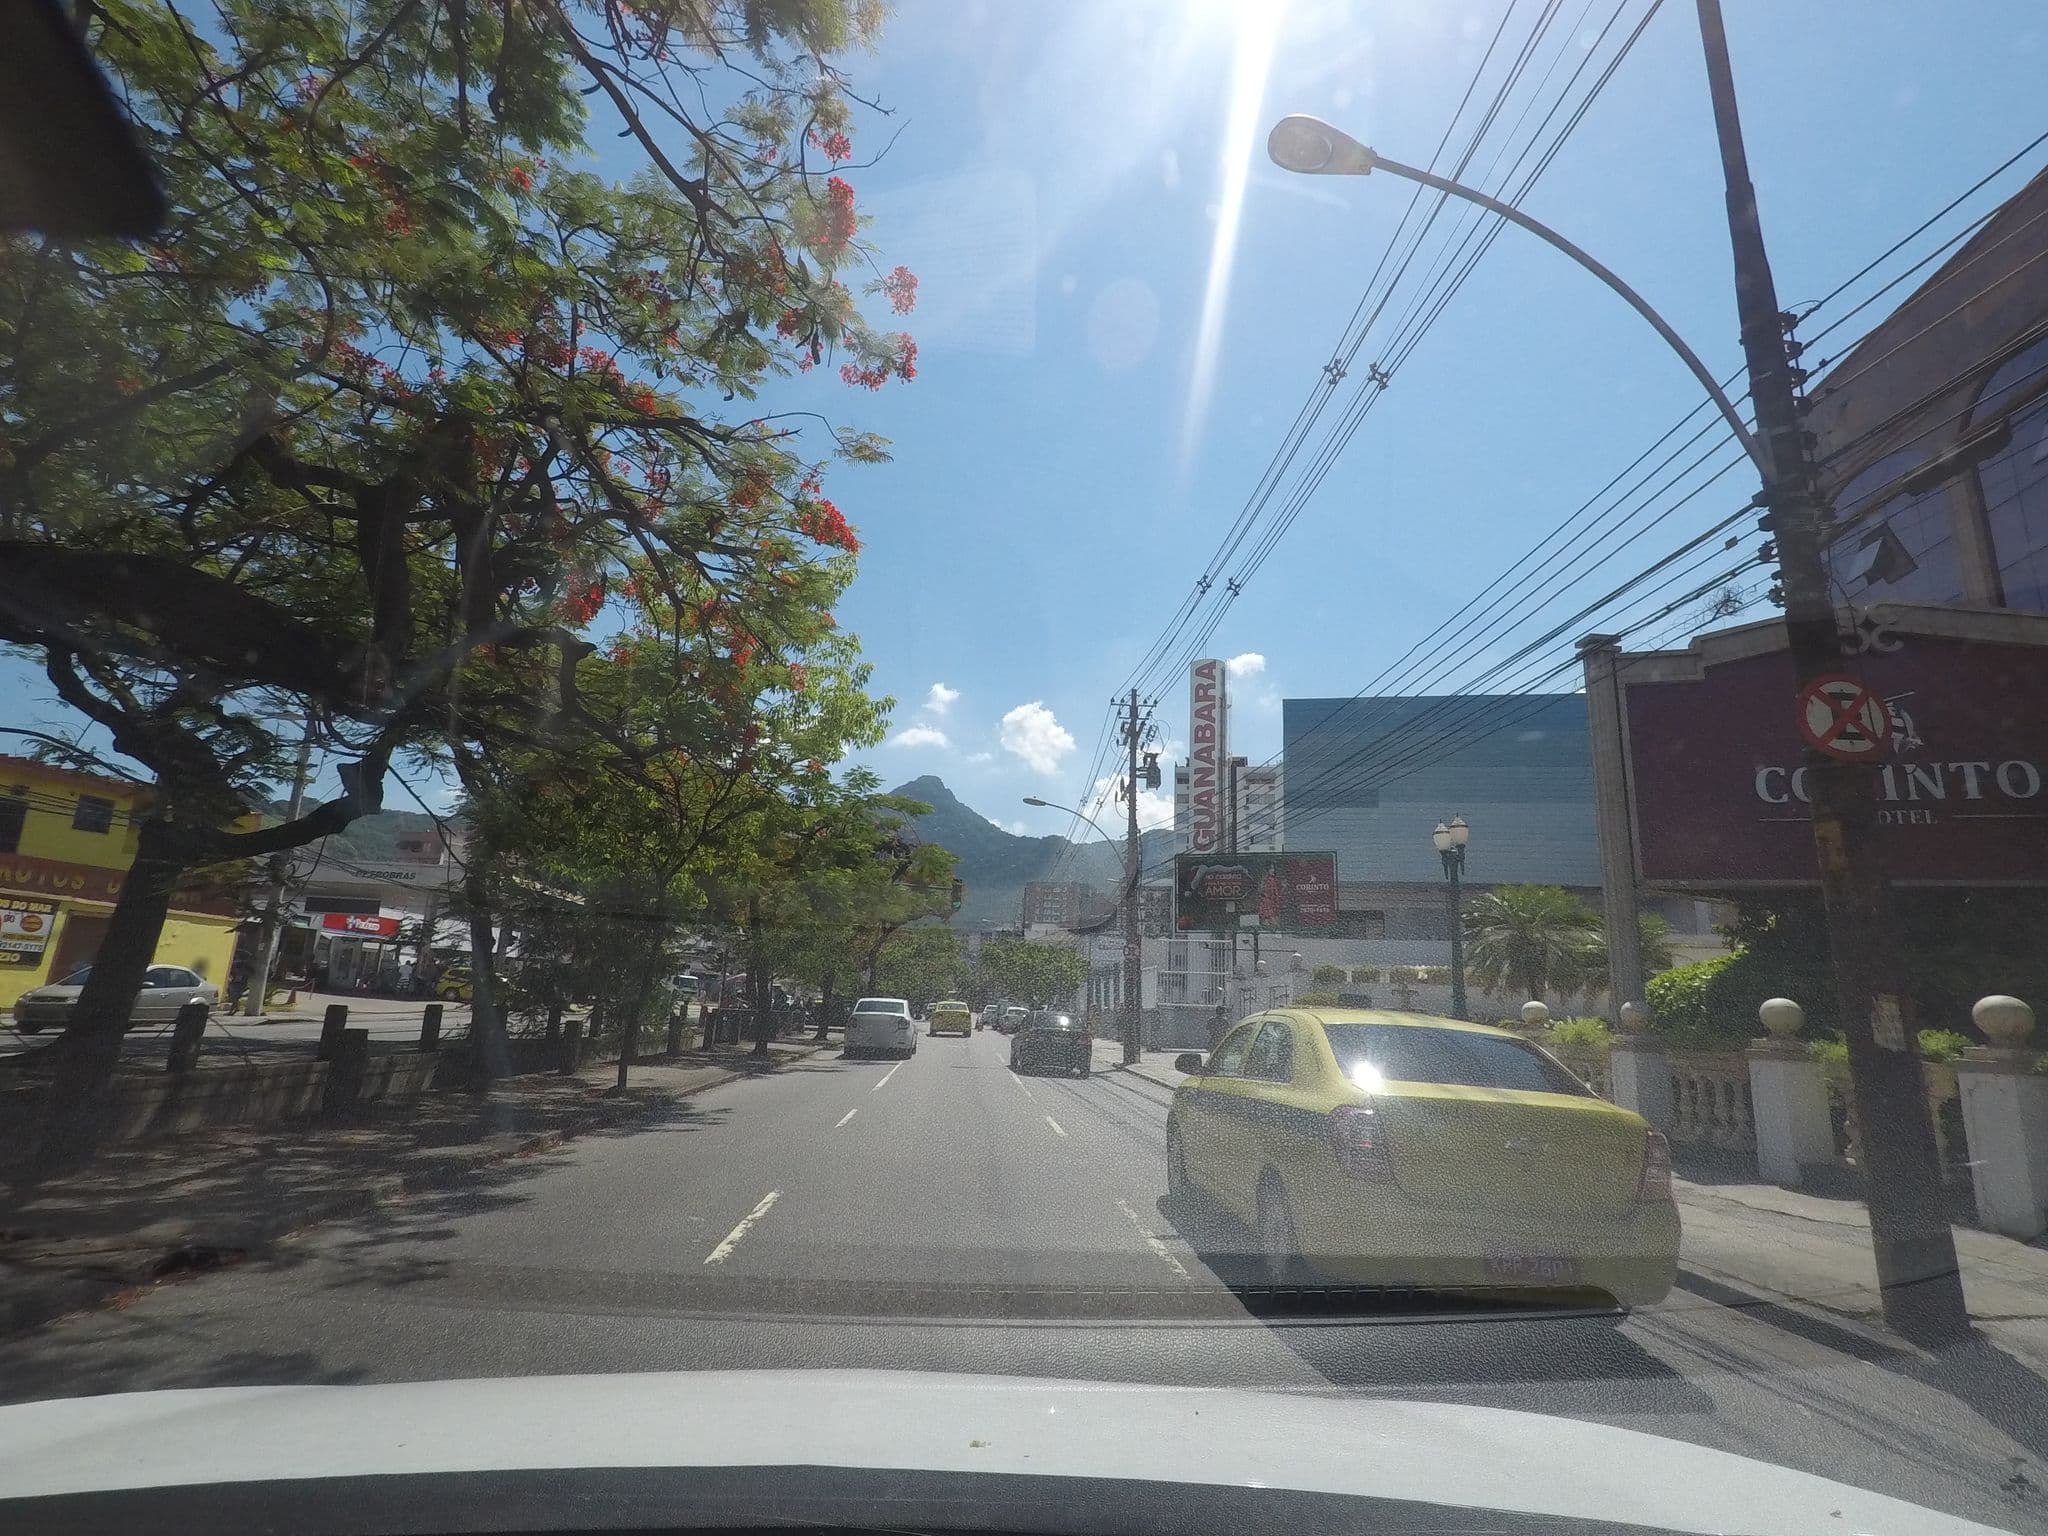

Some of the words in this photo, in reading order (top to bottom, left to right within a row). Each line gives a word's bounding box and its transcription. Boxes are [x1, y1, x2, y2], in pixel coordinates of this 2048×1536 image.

[1193, 659, 1217, 851] GUANABARA
[1755, 760, 2041, 803] CINTO
[1877, 809, 1938, 825] OTEL
[1205, 886, 1242, 897] AMOR
